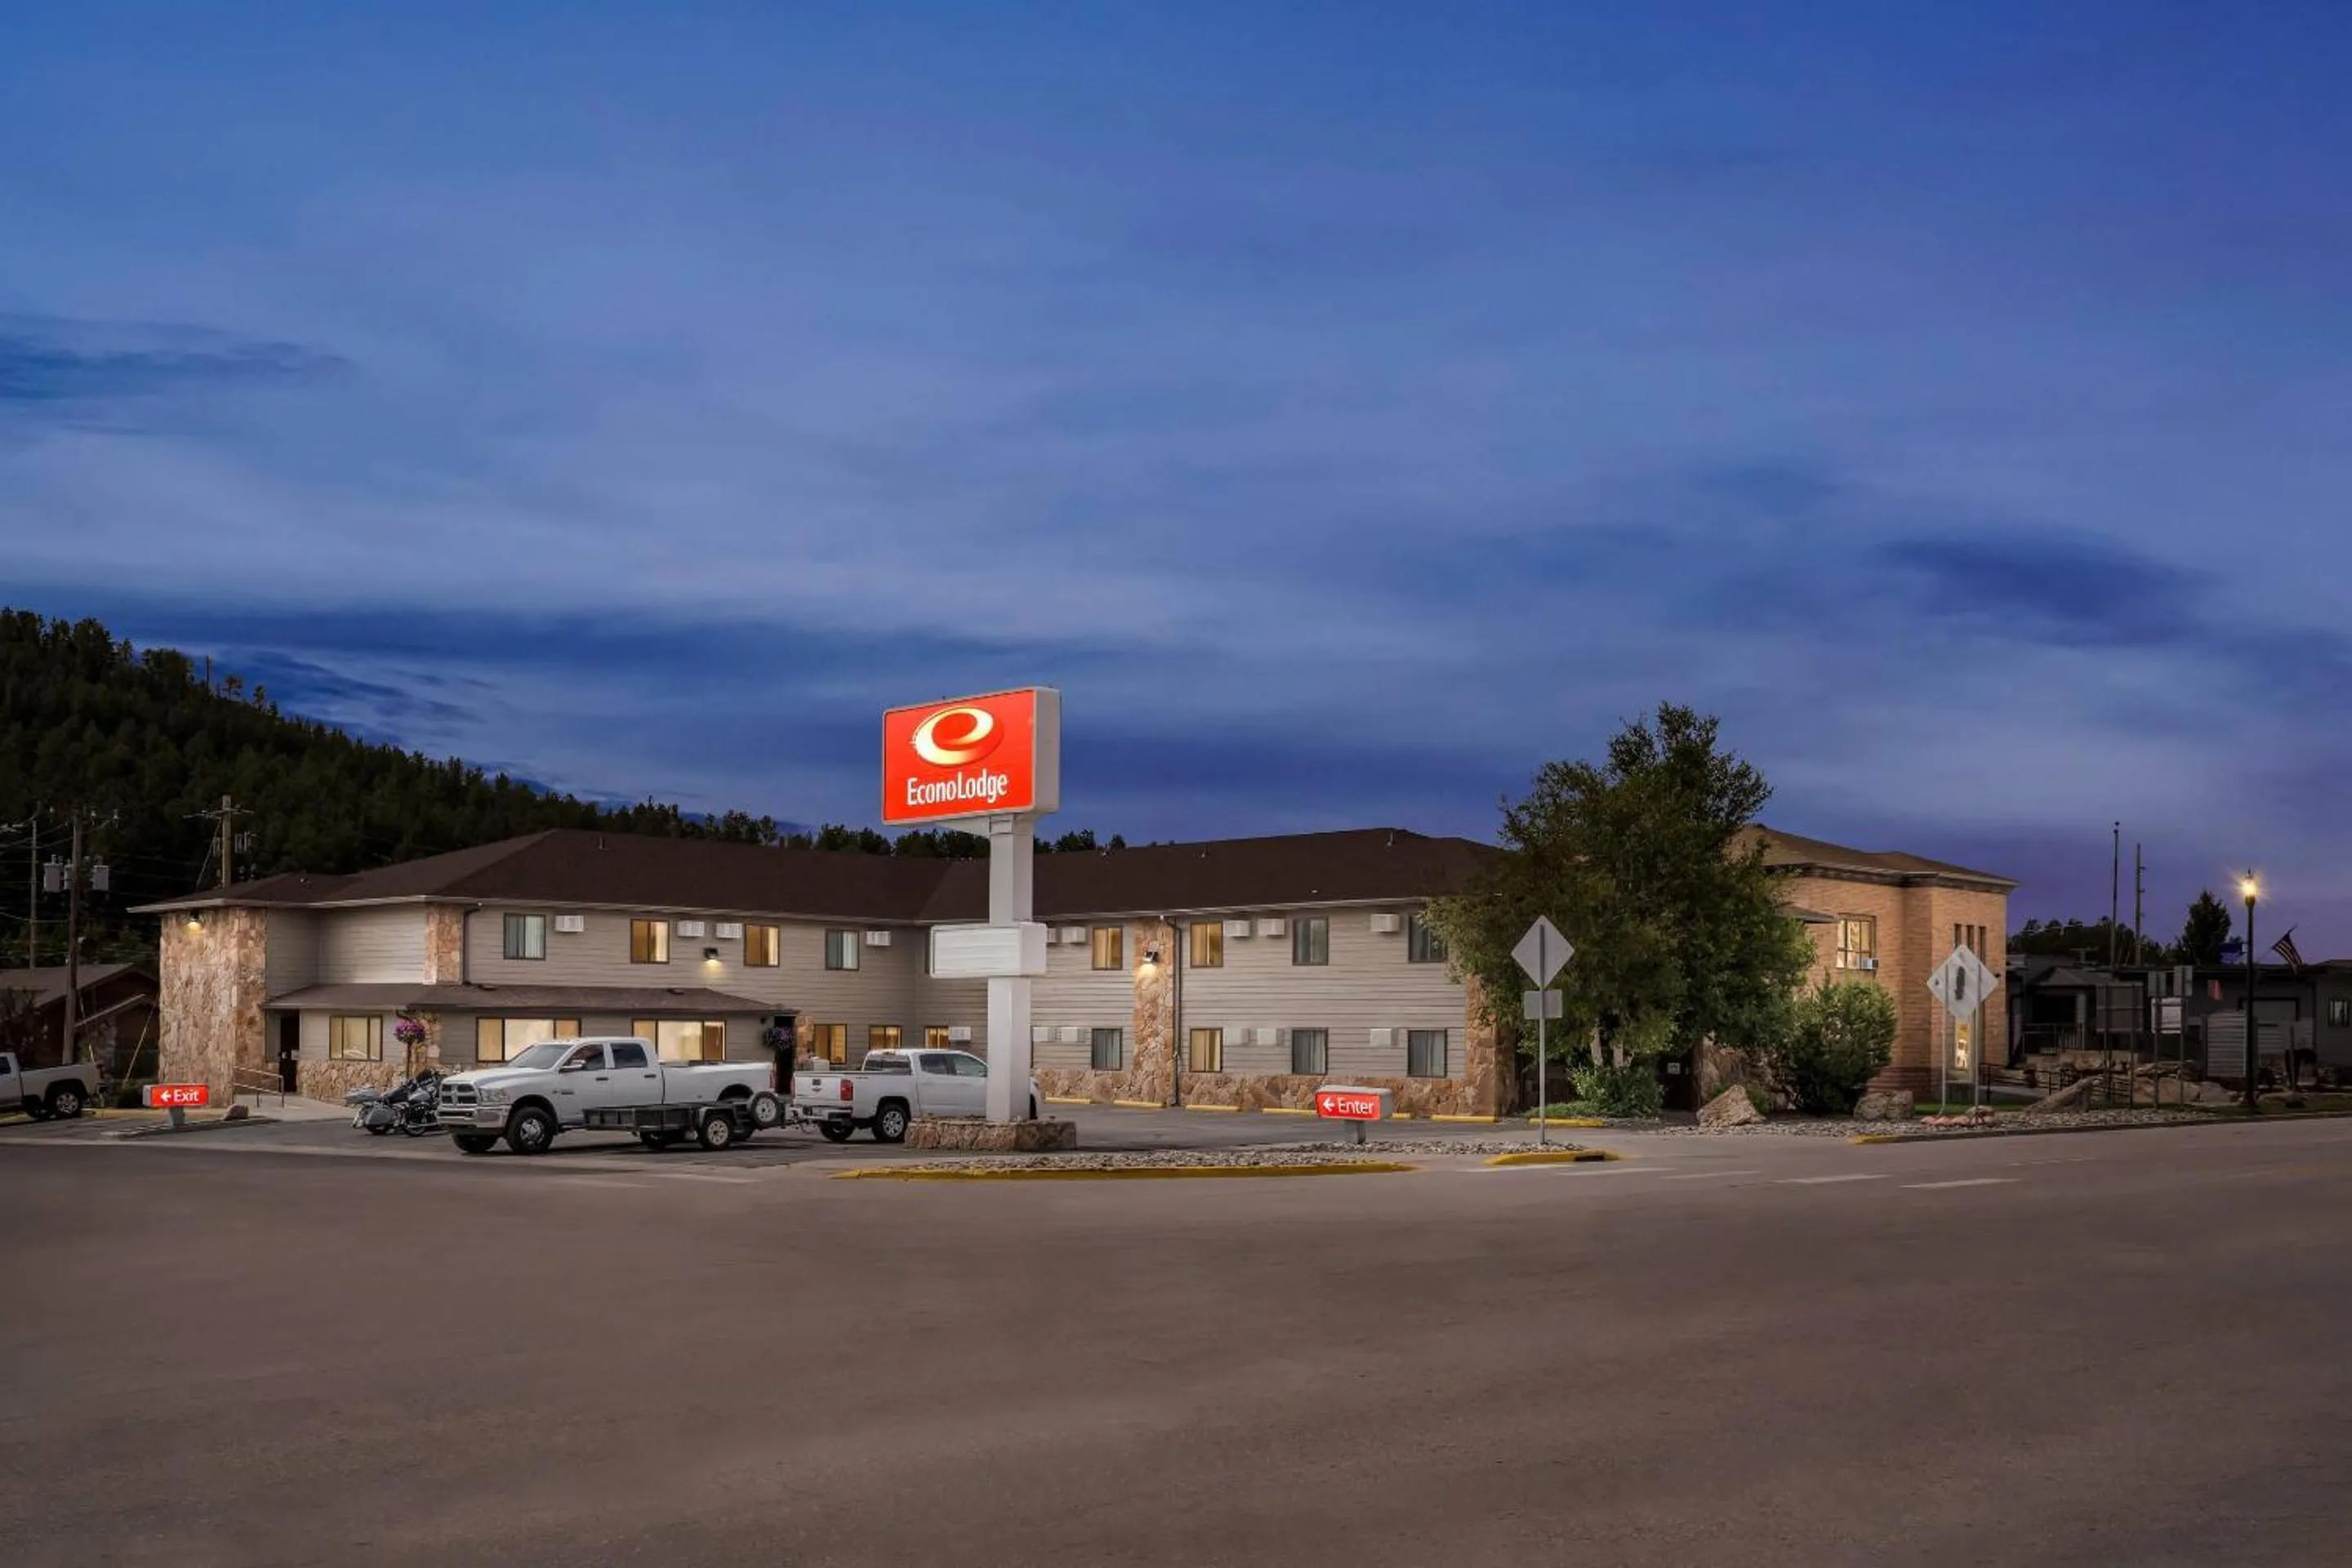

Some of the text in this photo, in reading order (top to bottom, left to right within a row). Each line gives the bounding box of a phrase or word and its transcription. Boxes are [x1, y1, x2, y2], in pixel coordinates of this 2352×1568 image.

[907, 768, 1008, 804] EconoLodge
[173, 1089, 199, 1102] Exit
[1338, 1097, 1374, 1114] Enter
